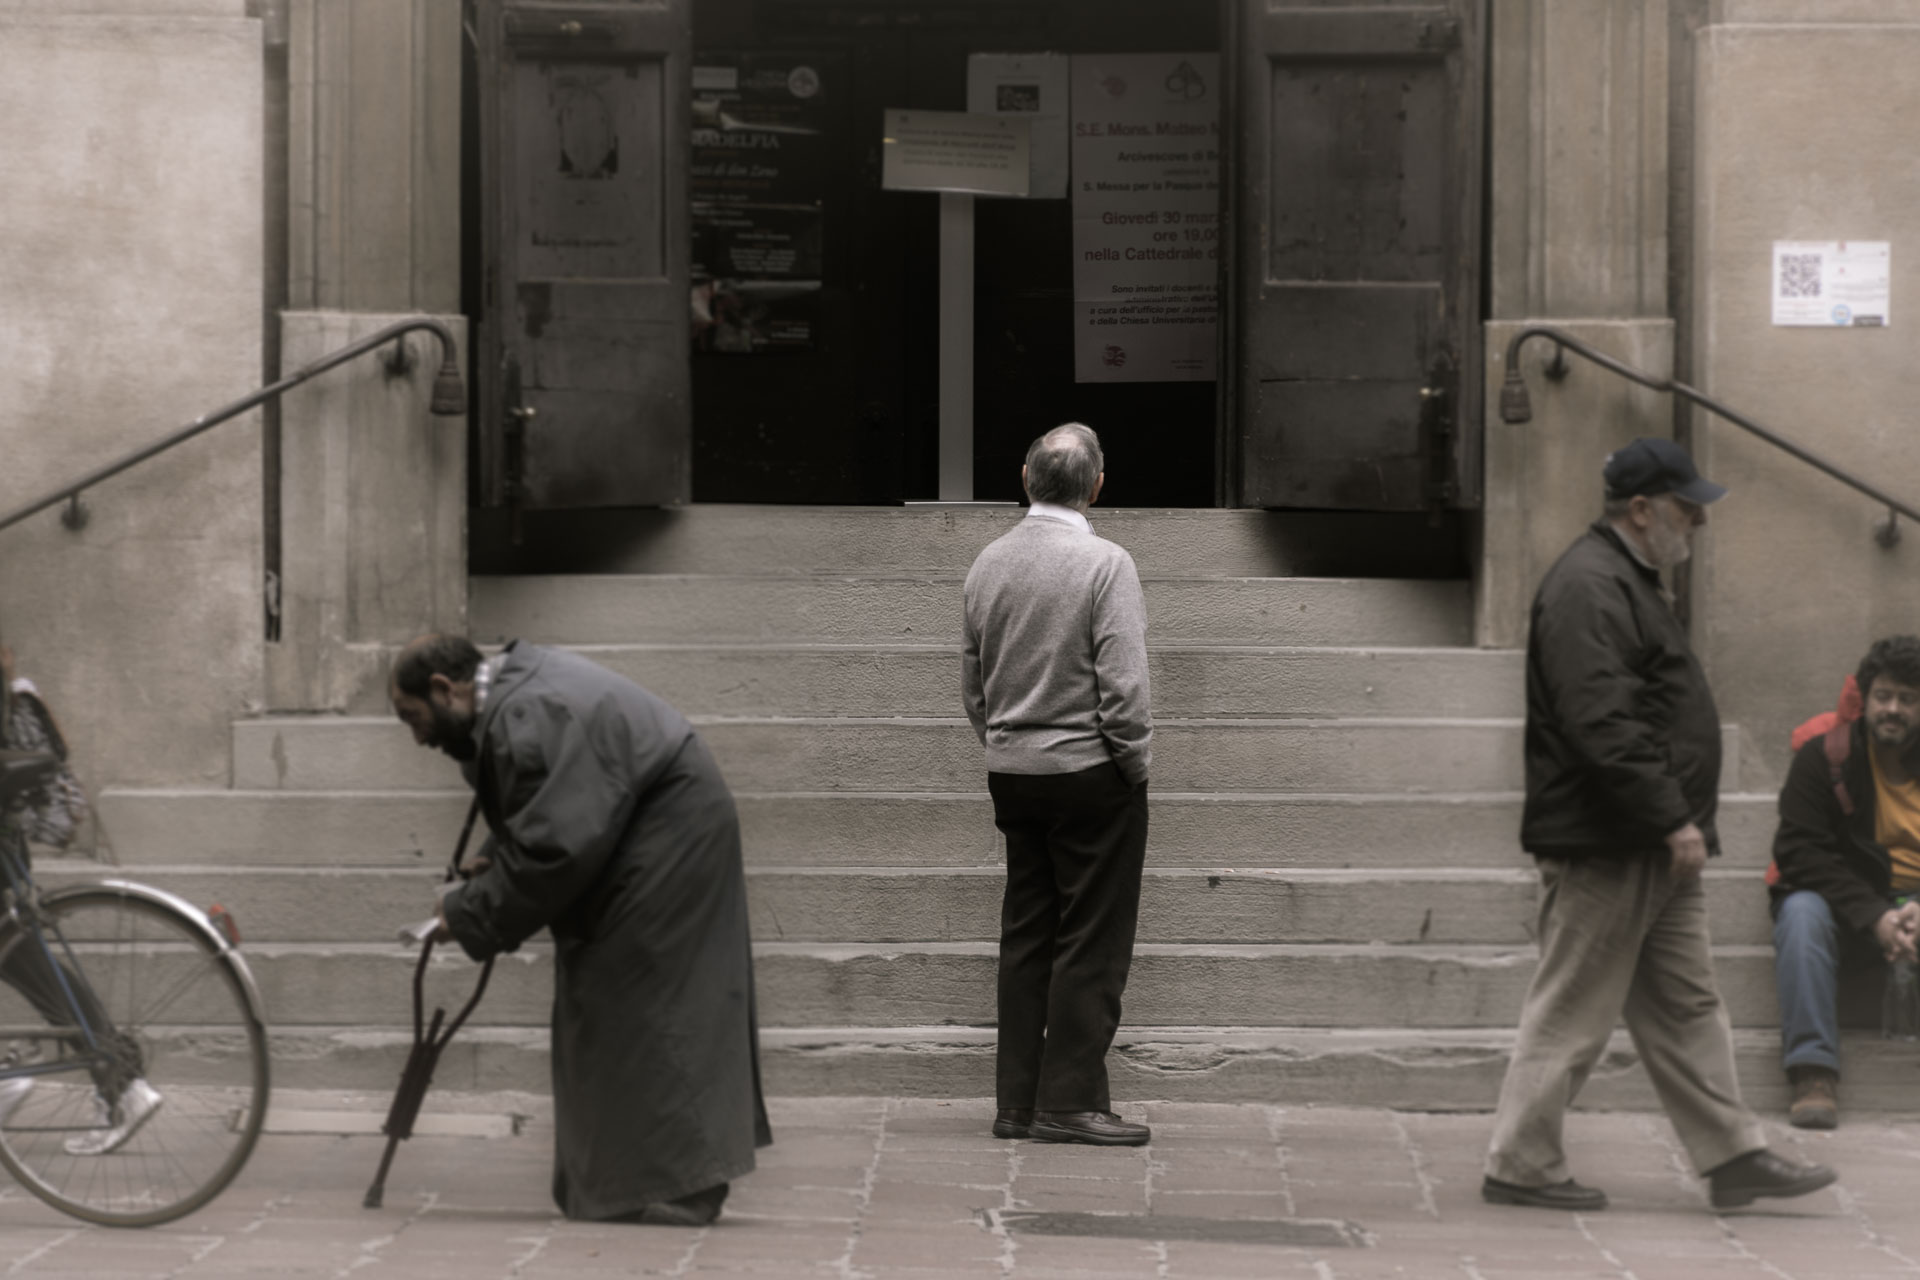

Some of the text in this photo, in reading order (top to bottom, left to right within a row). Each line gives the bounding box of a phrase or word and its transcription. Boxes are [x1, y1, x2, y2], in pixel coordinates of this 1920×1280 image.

[1155, 122, 1207, 136] Matteo
[1163, 210, 1181, 224] 30
[1152, 231, 1178, 242] ore
[1085, 247, 1120, 261] nella
[1125, 246, 1203, 261] Cattedrale
[1112, 285, 1133, 293] Sono
[1135, 284, 1164, 293] invitati
[1097, 316, 1118, 325] della
[1119, 316, 1150, 325] Chiesa
